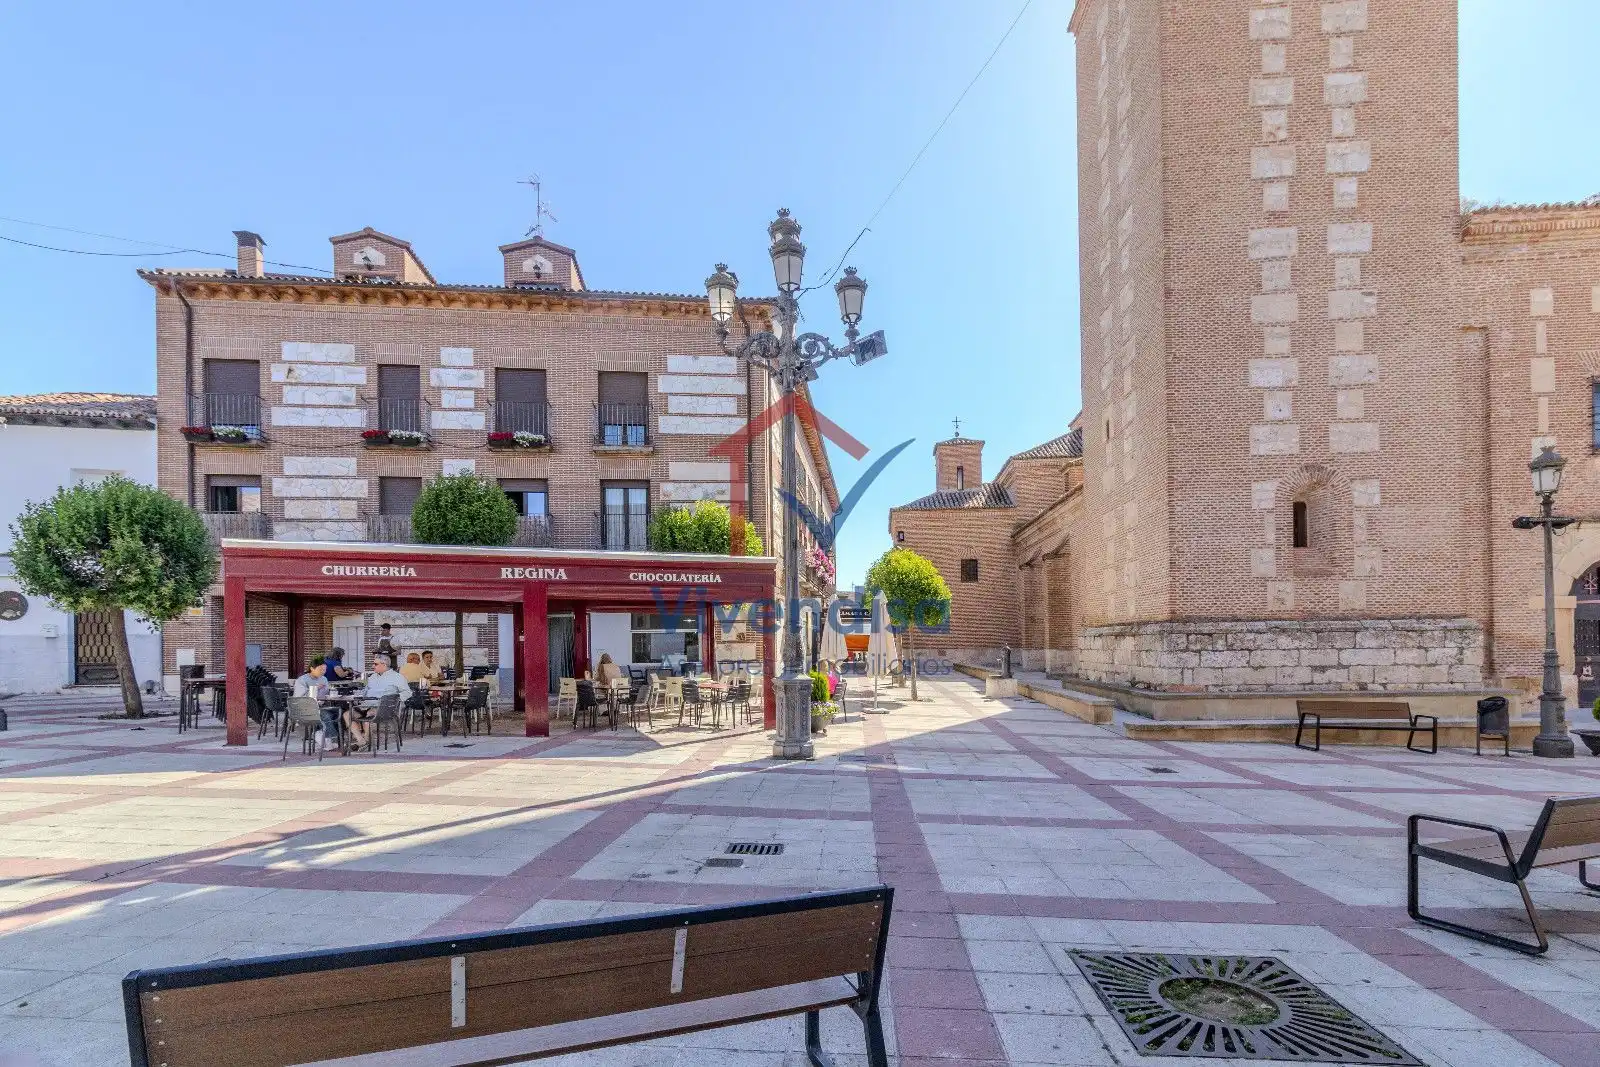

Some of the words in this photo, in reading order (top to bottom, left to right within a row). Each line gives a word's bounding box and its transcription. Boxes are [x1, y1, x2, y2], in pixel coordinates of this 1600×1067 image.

[321, 565, 417, 577] CHURRERÍA
[500, 567, 568, 580] REGINA
[629, 572, 722, 583] CHOCOLATERÍA
